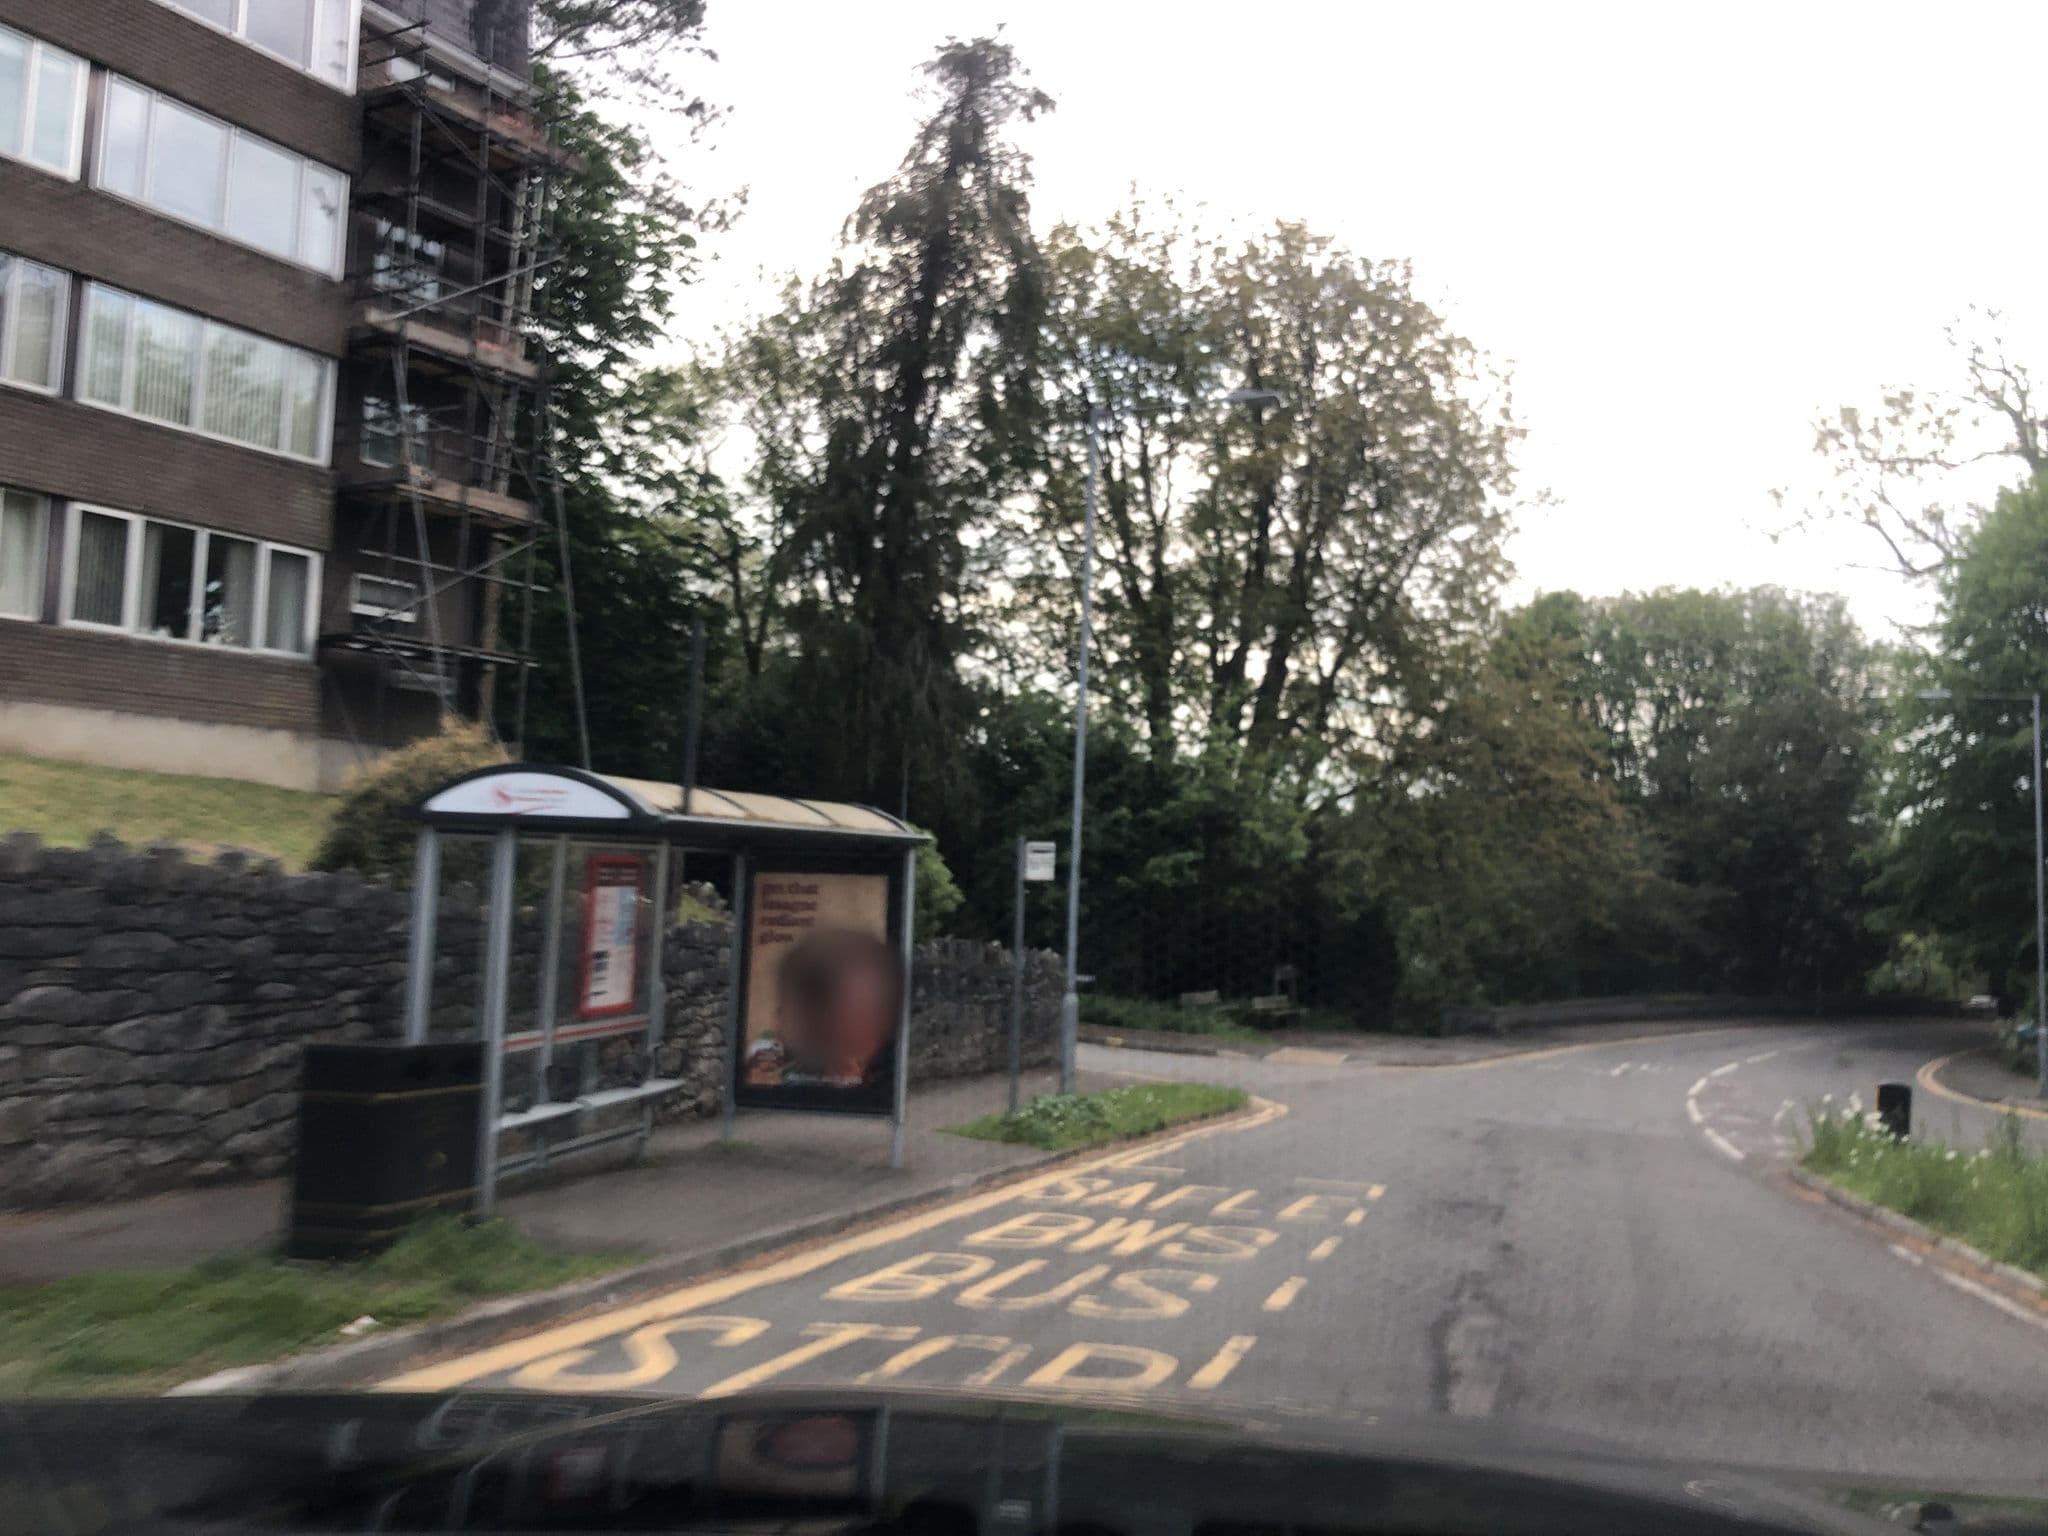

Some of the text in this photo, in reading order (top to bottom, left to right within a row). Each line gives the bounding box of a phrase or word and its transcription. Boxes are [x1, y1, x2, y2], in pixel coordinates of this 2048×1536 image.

[1019, 1178, 1358, 1222] SAFLE
[963, 1211, 1281, 1263] BWS
[821, 1251, 1219, 1320] BUS
